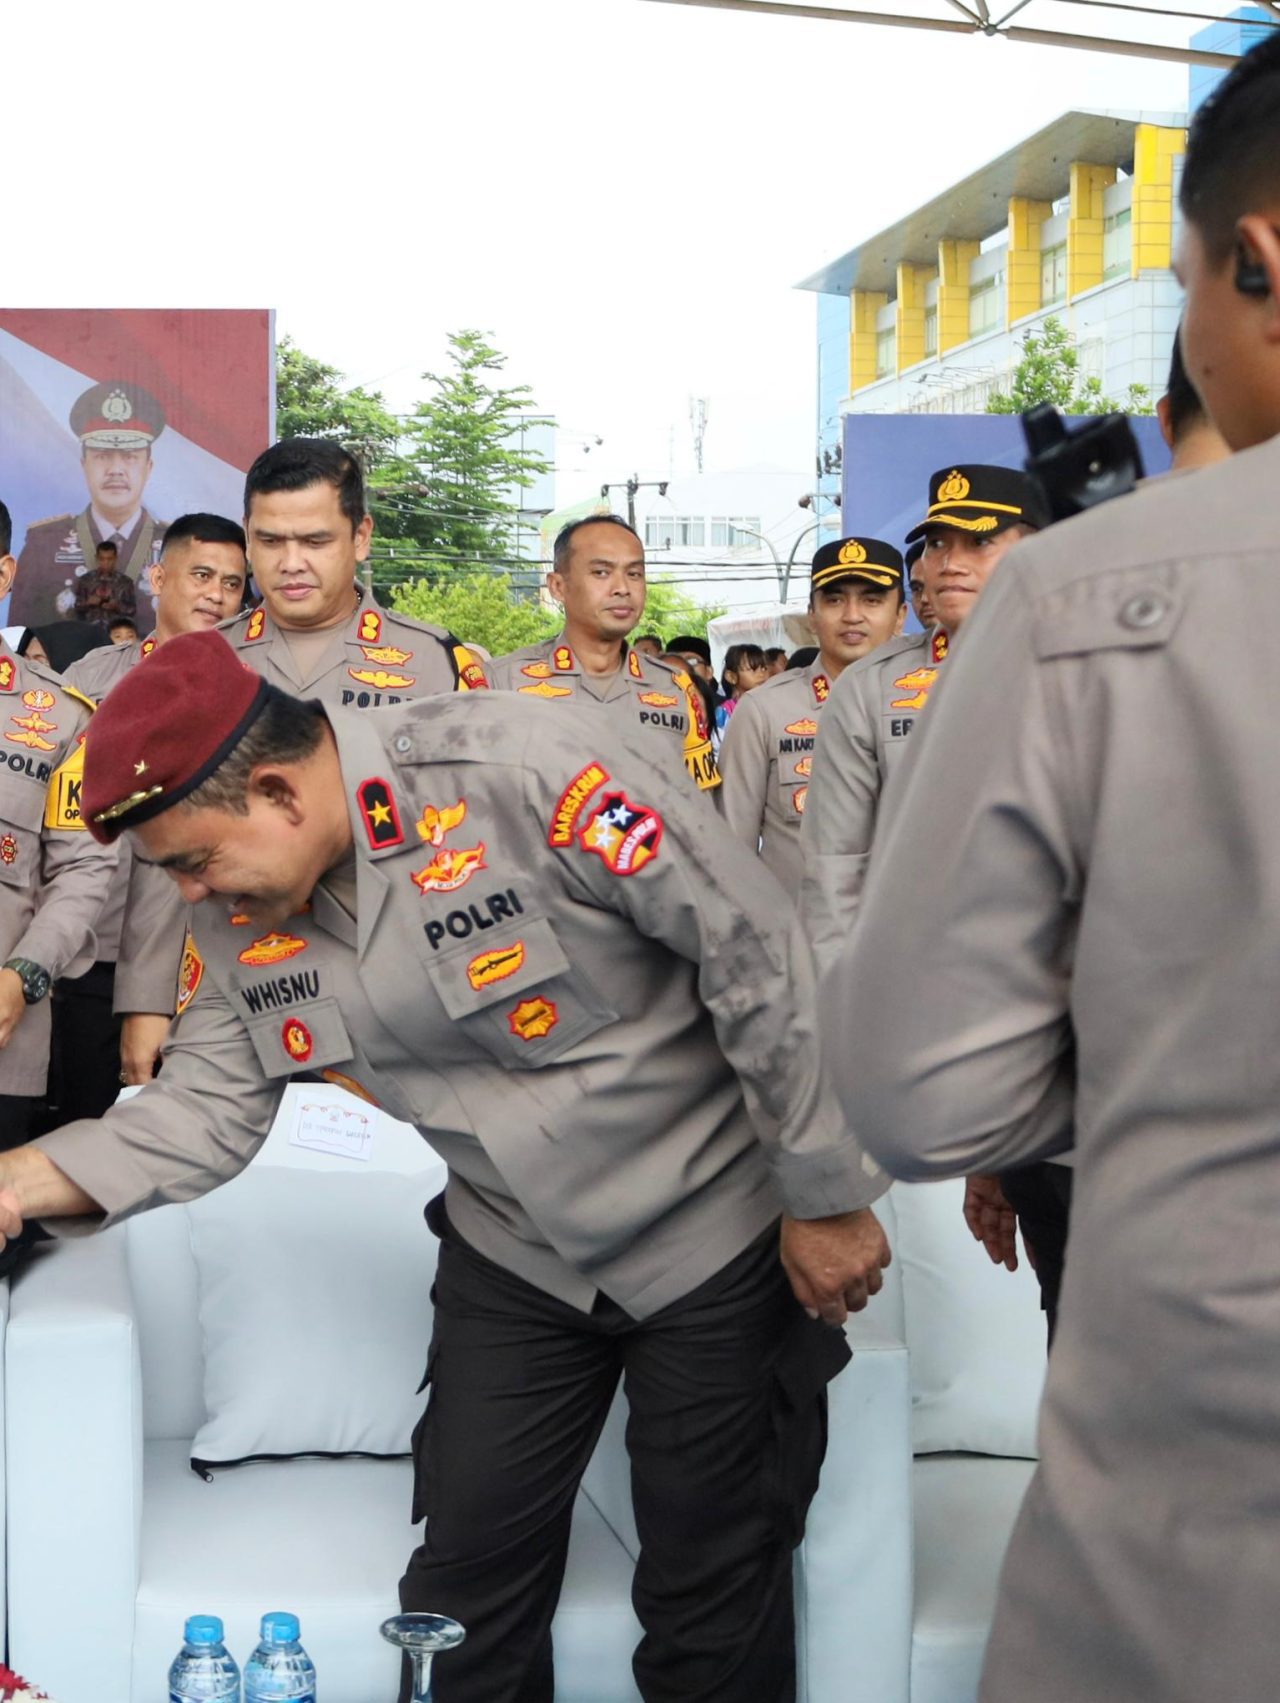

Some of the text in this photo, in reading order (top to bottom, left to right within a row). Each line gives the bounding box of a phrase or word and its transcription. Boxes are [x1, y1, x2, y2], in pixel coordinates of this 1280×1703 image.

[639, 711, 684, 731] POLRI
[66, 778, 82, 808] K
[552, 765, 605, 842] BARESKRIM
[64, 808, 81, 820] OP
[423, 888, 524, 950] POLRI
[240, 969, 320, 1015] WHISNU
